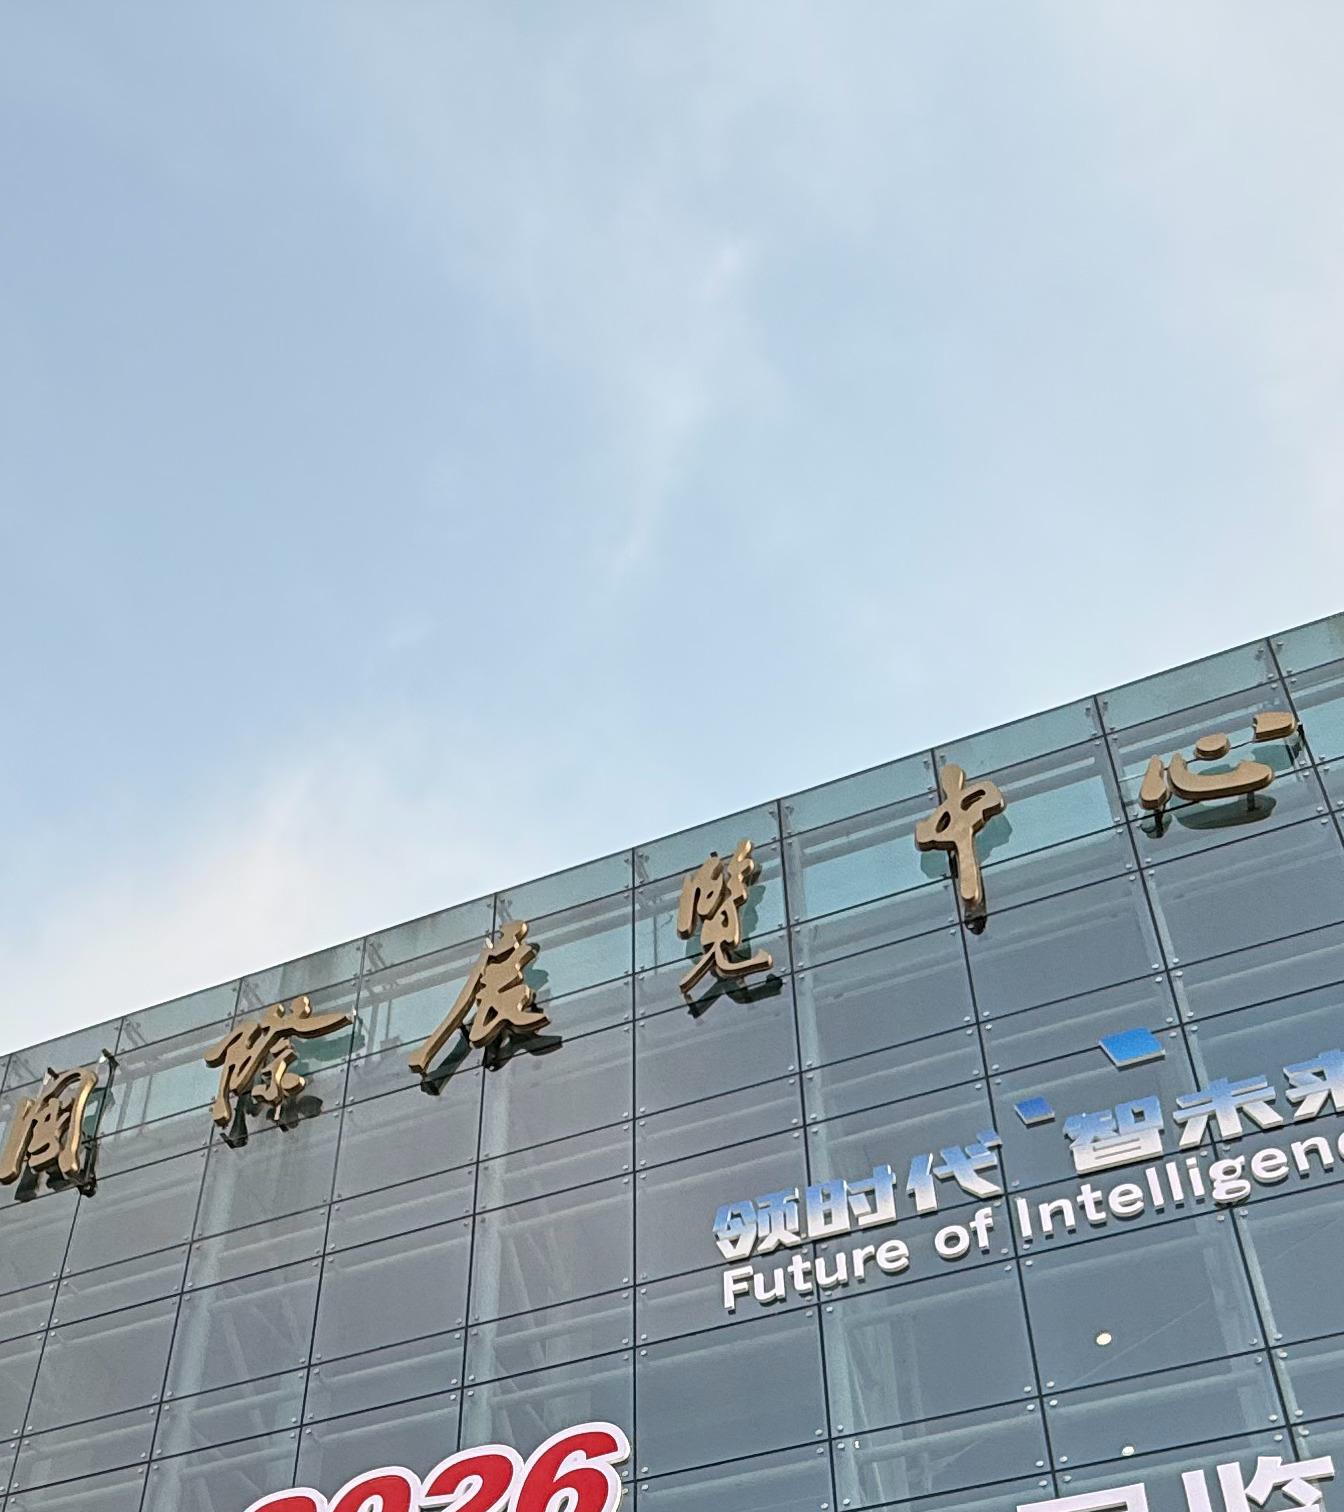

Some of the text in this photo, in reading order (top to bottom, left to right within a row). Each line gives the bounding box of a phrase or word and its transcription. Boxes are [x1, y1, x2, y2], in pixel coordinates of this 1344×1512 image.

[712, 1130, 1002, 1261] 领时代
[723, 1237, 910, 1312] Future
[934, 1206, 995, 1259] of
